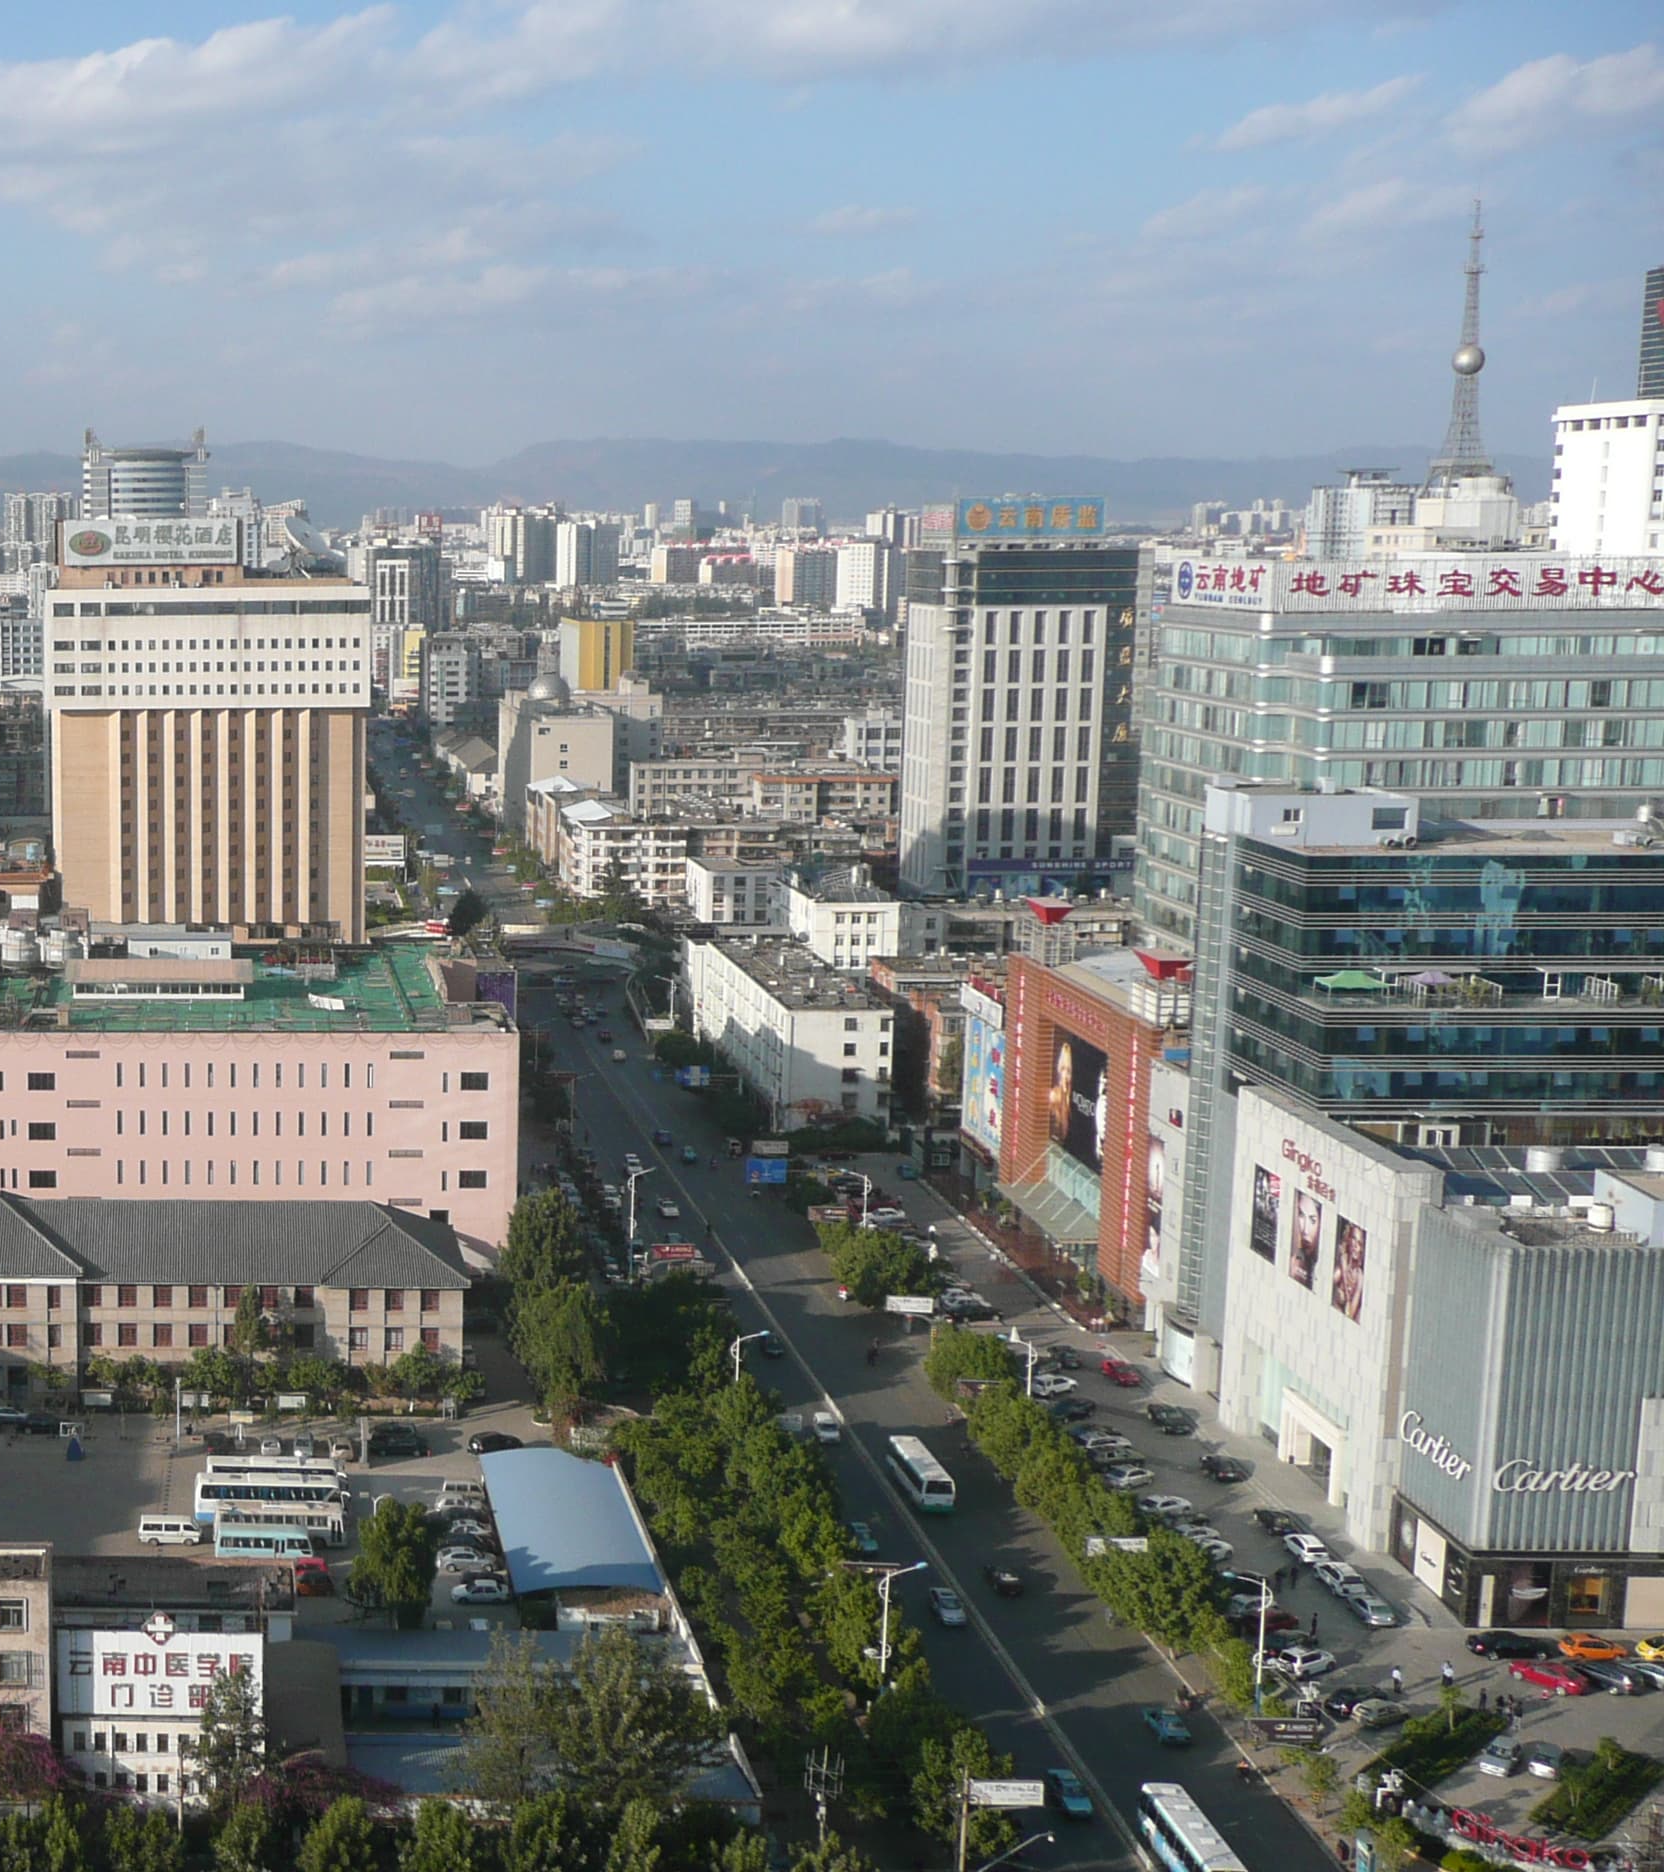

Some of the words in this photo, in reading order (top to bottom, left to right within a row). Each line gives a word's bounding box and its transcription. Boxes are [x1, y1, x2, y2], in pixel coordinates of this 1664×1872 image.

[999, 505, 1099, 528] 云南质监
[115, 524, 233, 546] 昆明樱花酒店
[154, 551, 185, 559] HOTEL
[1195, 564, 1266, 592] 云南地矿
[1290, 566, 1664, 597] 地矿珠宝交易中心
[1282, 1138, 1322, 1177] Gingko
[1400, 1410, 1472, 1480] Cartier
[1493, 1459, 1635, 1492] Cartier
[69, 1652, 254, 1677] 云南中医学院
[111, 1683, 212, 1708] 门诊部
[1451, 1808, 1591, 1870] Gingko
